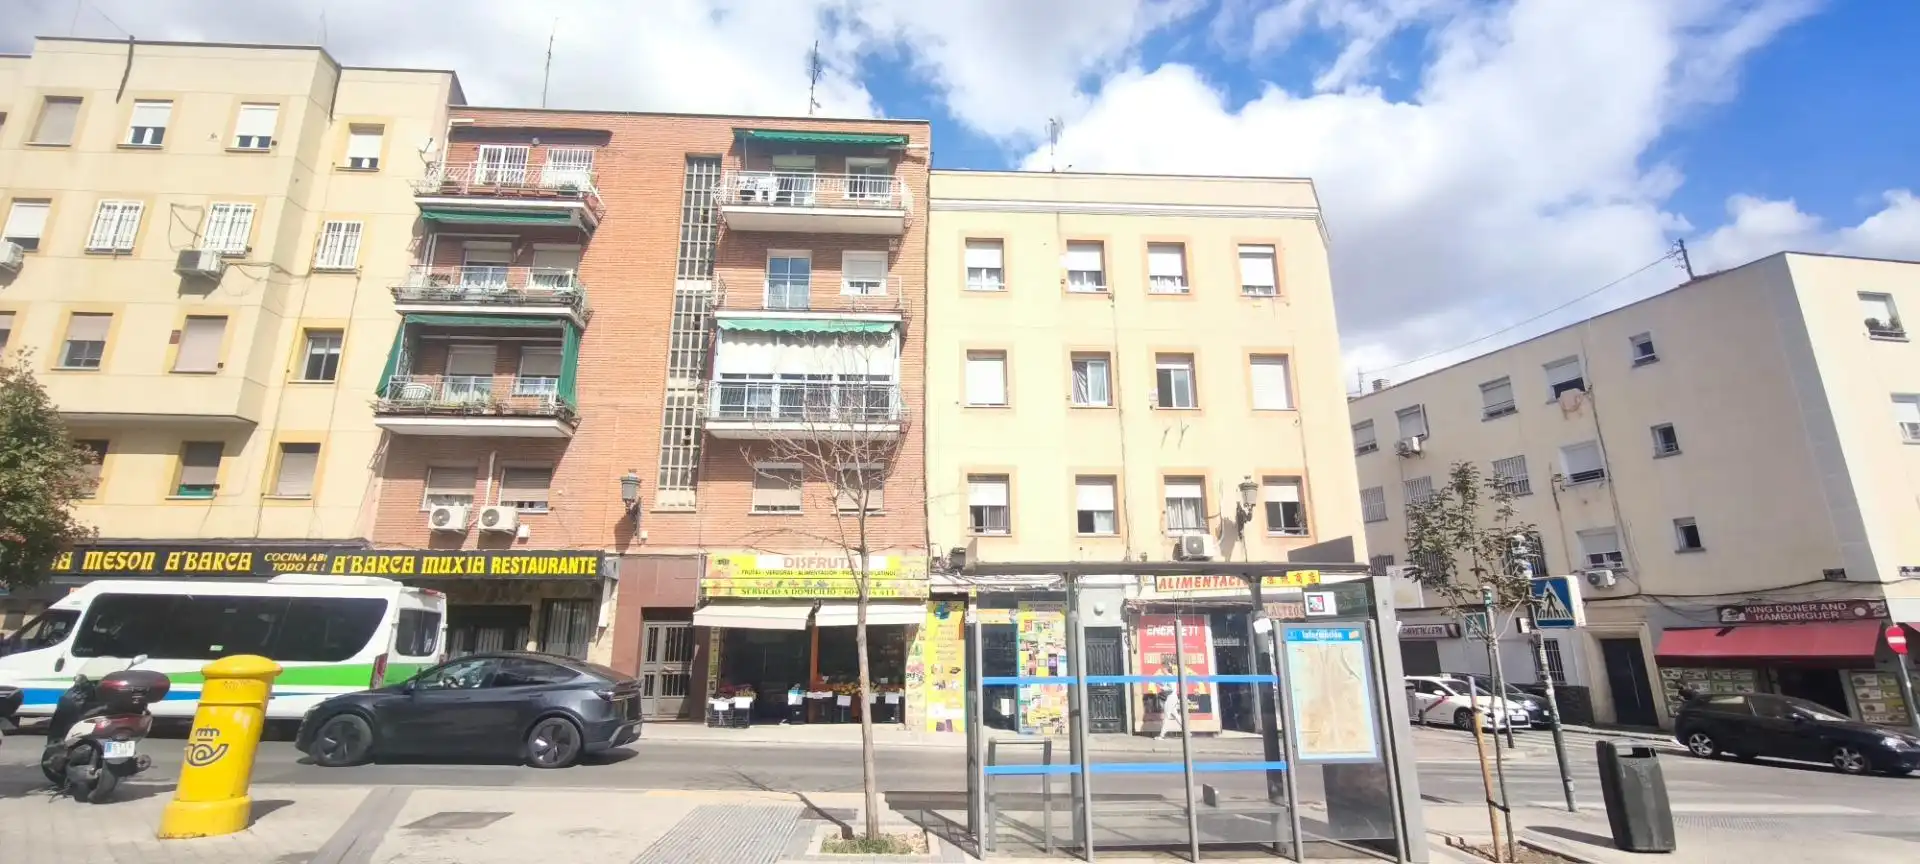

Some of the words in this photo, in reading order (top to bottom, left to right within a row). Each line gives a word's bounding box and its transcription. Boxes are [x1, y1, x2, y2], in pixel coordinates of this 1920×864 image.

[82, 551, 155, 571] MESON
[264, 552, 307, 562] COCINA
[783, 557, 858, 569] DISFRUTA
[272, 562, 304, 571] TODO
[306, 562, 318, 571] EL
[420, 556, 486, 574] MUXIA
[491, 556, 597, 575] RESTAURANTE
[1744, 605, 1773, 614] KING
[1776, 603, 1817, 613] DONER
[1820, 602, 1847, 611] AND
[1755, 610, 1840, 621] HAMBURGUER
